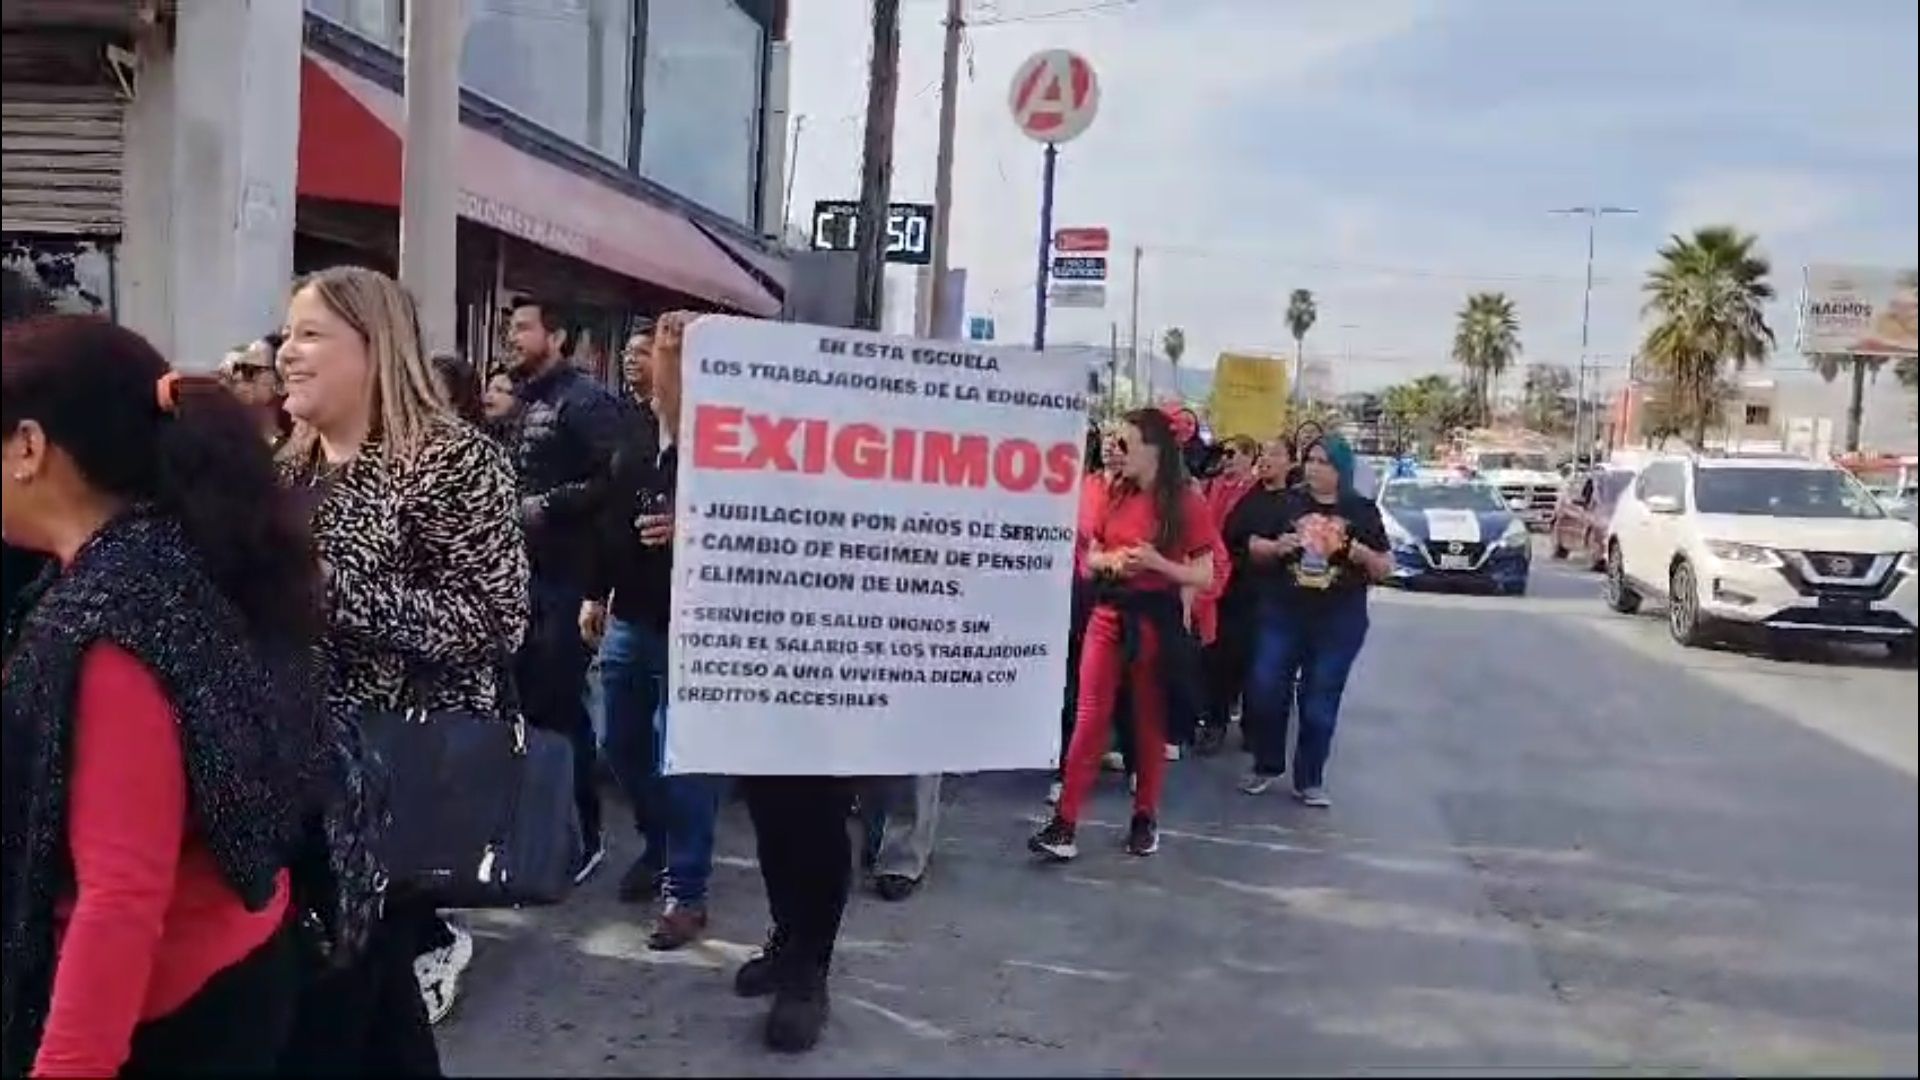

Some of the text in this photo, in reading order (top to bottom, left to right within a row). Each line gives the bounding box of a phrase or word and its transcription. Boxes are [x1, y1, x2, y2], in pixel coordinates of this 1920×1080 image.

[819, 338, 1000, 371] EN ESTA ESCUELA
[700, 358, 742, 376] LOS
[748, 363, 917, 394] TRABAJADORES
[923, 382, 950, 398] DE
[955, 385, 979, 402] LA
[693, 404, 1081, 494] EXIGIMOS
[703, 503, 1073, 542] JUBILACION POR AÑOS DE SERVICIO
[702, 533, 1053, 571] CAMBIO DE REGIMEN DE PENSION
[700, 565, 965, 598] ELIMINACION DE UMAS.
[694, 607, 990, 633] SERVICIO DE SALUD DIGNOS SIN
[681, 633, 1048, 658] TOCAR EL SALARIO SE LOS TRABAJADORES
[691, 661, 1017, 683] ACCESO A UNA VIVIENDA DIGNA CON
[677, 686, 889, 707] CREDITOS ACCESIBLES
